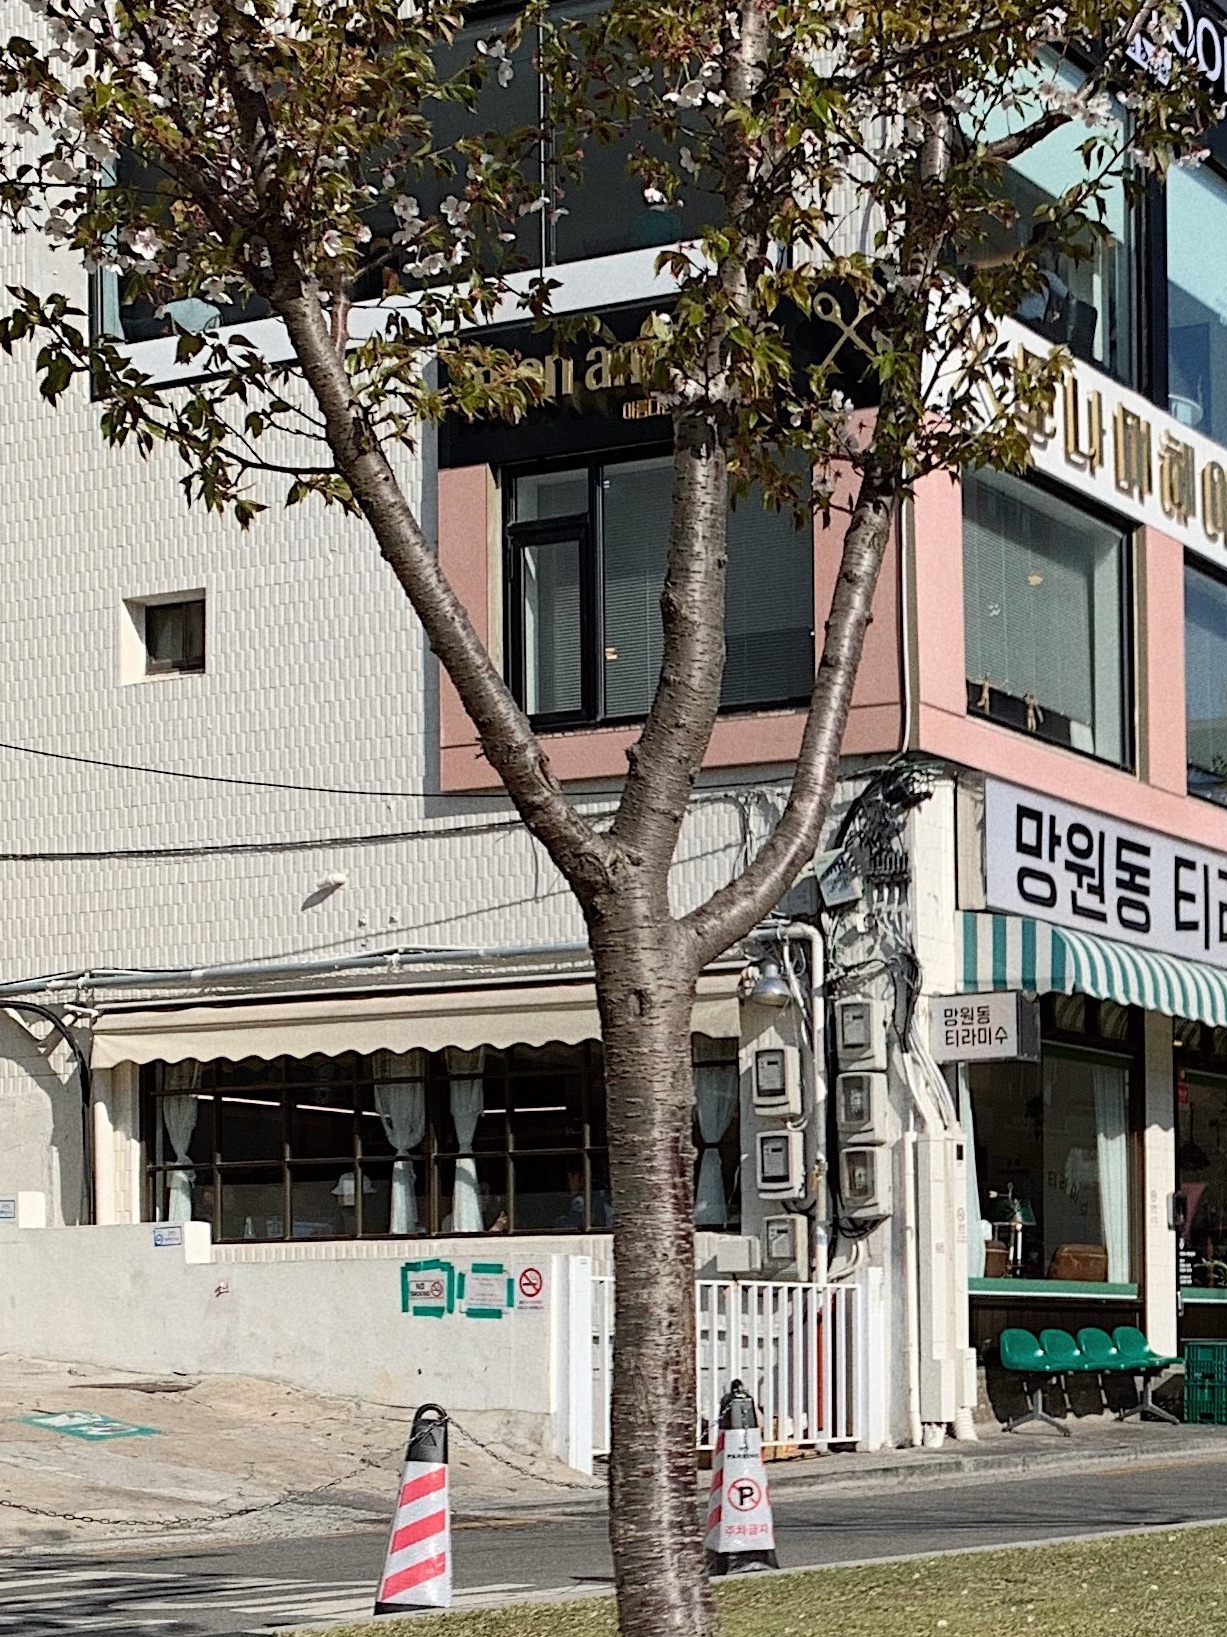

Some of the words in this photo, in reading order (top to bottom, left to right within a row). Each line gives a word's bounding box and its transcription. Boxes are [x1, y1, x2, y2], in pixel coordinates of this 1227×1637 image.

[1016, 803, 1151, 933] 망원동
[944, 1005, 990, 1027] 망원동
[945, 1026, 1008, 1047] 티라미수
[724, 1523, 768, 1537] 주차금지
